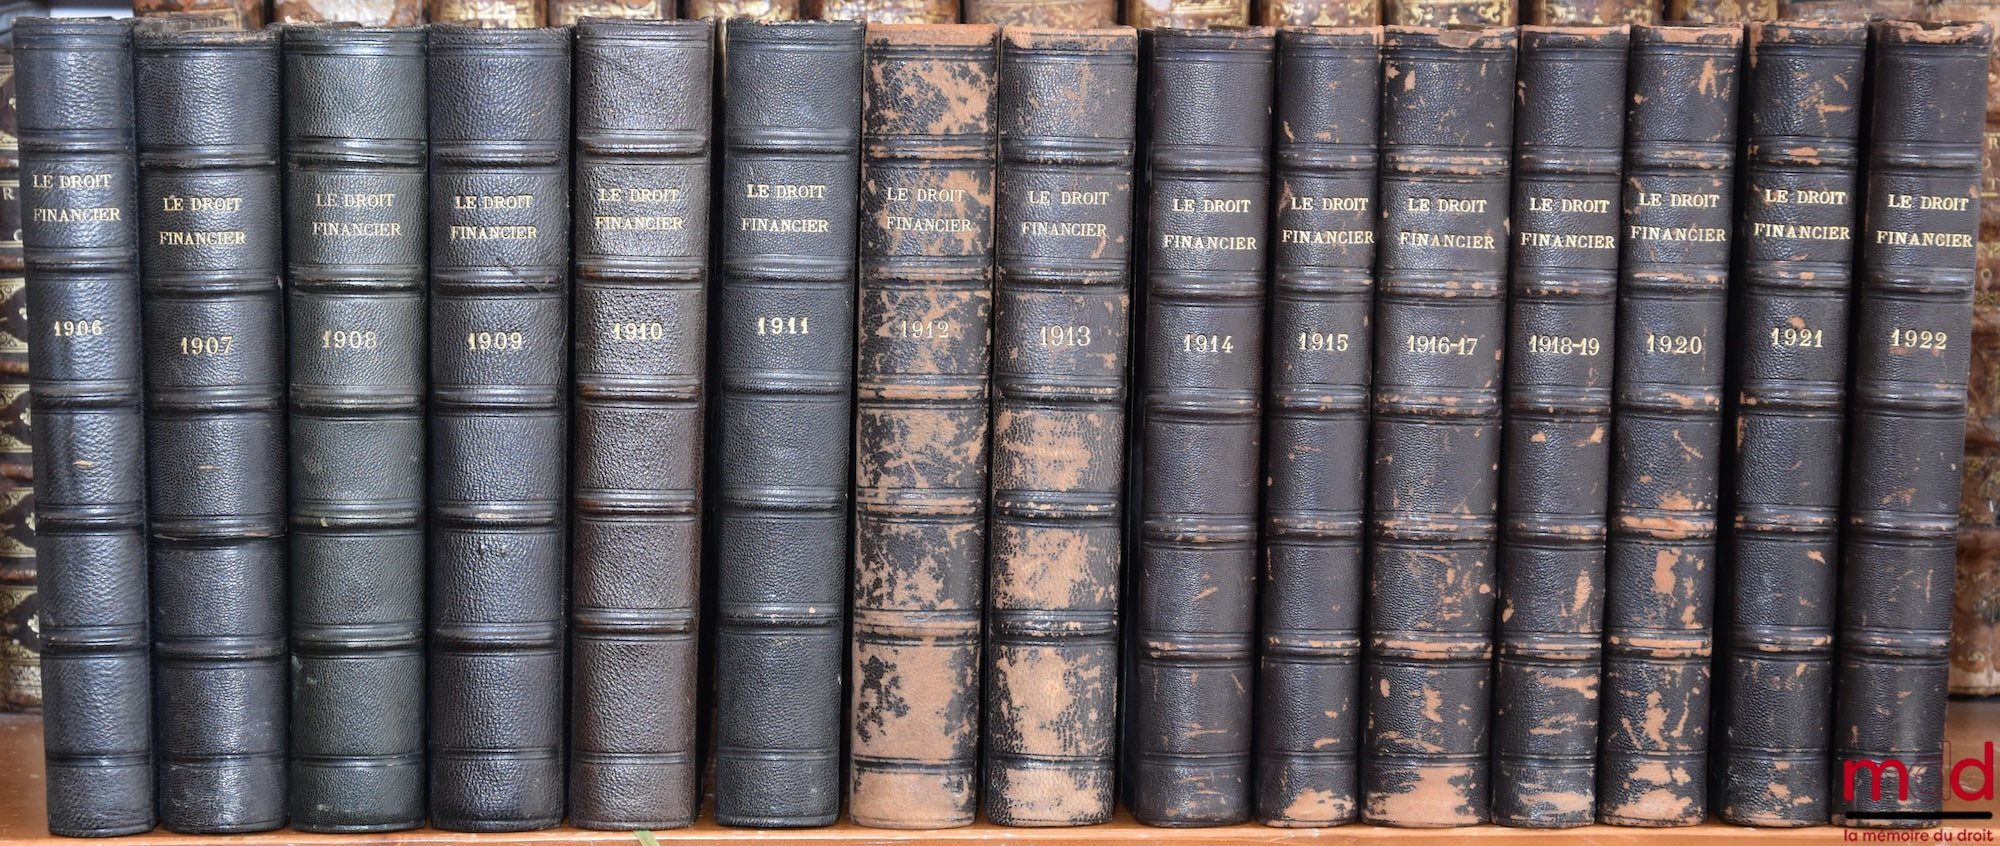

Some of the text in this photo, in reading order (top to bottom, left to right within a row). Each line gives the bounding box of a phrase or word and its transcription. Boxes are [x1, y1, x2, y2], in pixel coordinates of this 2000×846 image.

[33, 174, 110, 188] LE DROIT
[600, 188, 680, 201] LE DROIT
[747, 184, 826, 199] LE DROIT
[887, 187, 965, 202] LE DROIT
[1029, 191, 1109, 205] LE DROIT
[1765, 188, 1846, 205] LE DROIT
[163, 198, 242, 212] LE DROIT
[316, 194, 394, 207] LE DROIT
[455, 195, 534, 209] LE DROIT
[1172, 198, 1251, 213] LE DROIT
[1290, 197, 1368, 211] LE DROIT
[1408, 198, 1487, 213] LE DROIT
[1529, 198, 1610, 213] LE DROIT
[1639, 193, 1720, 208] LE DROIT
[1888, 194, 1969, 211] LE DROIT
[33, 208, 121, 222] FINANCIER
[312, 221, 401, 236] FINANCIER
[596, 216, 684, 230] FINANCIER
[742, 218, 829, 232] FINANCIER
[887, 217, 972, 232] FINANCIER
[1022, 222, 1107, 237] FINANCIER
[159, 231, 246, 245] FINANCIER
[451, 225, 537, 239] FINANCIER
[1282, 230, 1374, 244] FINANCIER
[1631, 225, 1726, 241] FINANCIER
[1754, 222, 1850, 240] FINANCIER
[1164, 235, 1257, 250] FINANCIER
[1399, 232, 1495, 250] FINANCIER
[1520, 232, 1615, 249] FINANCIER
[1876, 230, 1973, 248] FINANCIER
[54, 320, 103, 337] 1906
[613, 322, 663, 340] 1910
[757, 316, 809, 335] 1911
[900, 320, 949, 339] 1912
[322, 330, 377, 349] 1908
[468, 332, 522, 350] 1909
[1039, 325, 1091, 347] 1913
[1184, 334, 1233, 353] 1914
[1299, 333, 1349, 352] 1915
[1771, 327, 1823, 348] 1921
[1891, 328, 1948, 350] 1922
[180, 336, 233, 355] 1907
[1408, 335, 1478, 355] 1916-17
[1529, 334, 1600, 355] 1918-19
[1647, 334, 1702, 354] 1920
